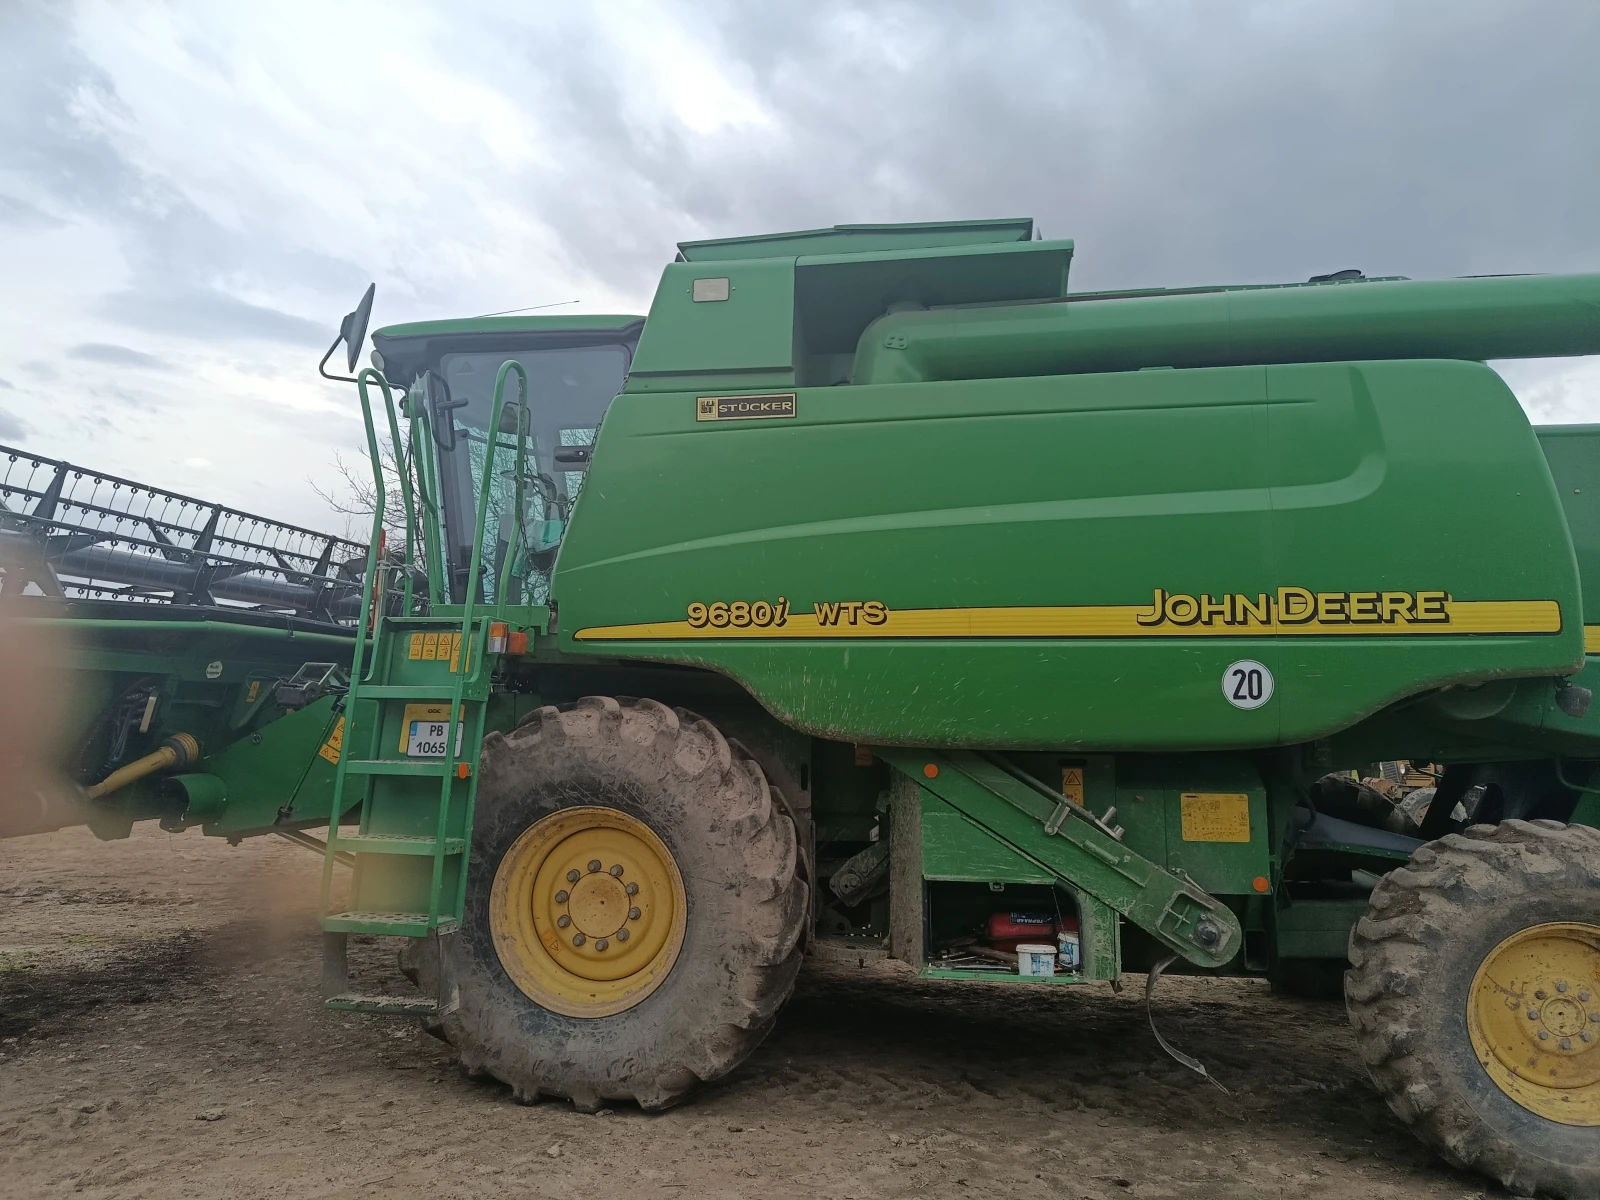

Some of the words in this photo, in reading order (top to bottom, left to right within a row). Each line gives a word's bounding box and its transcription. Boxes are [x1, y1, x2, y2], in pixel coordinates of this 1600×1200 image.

[718, 401, 792, 413] STÜCKER
[687, 596, 790, 628] 9680i
[814, 601, 889, 626] WTS
[1137, 588, 1274, 626] JOHN
[1277, 586, 1452, 625] DEERE
[1232, 668, 1263, 700] 20
[429, 725, 444, 737] PB
[416, 742, 447, 754] 1065
